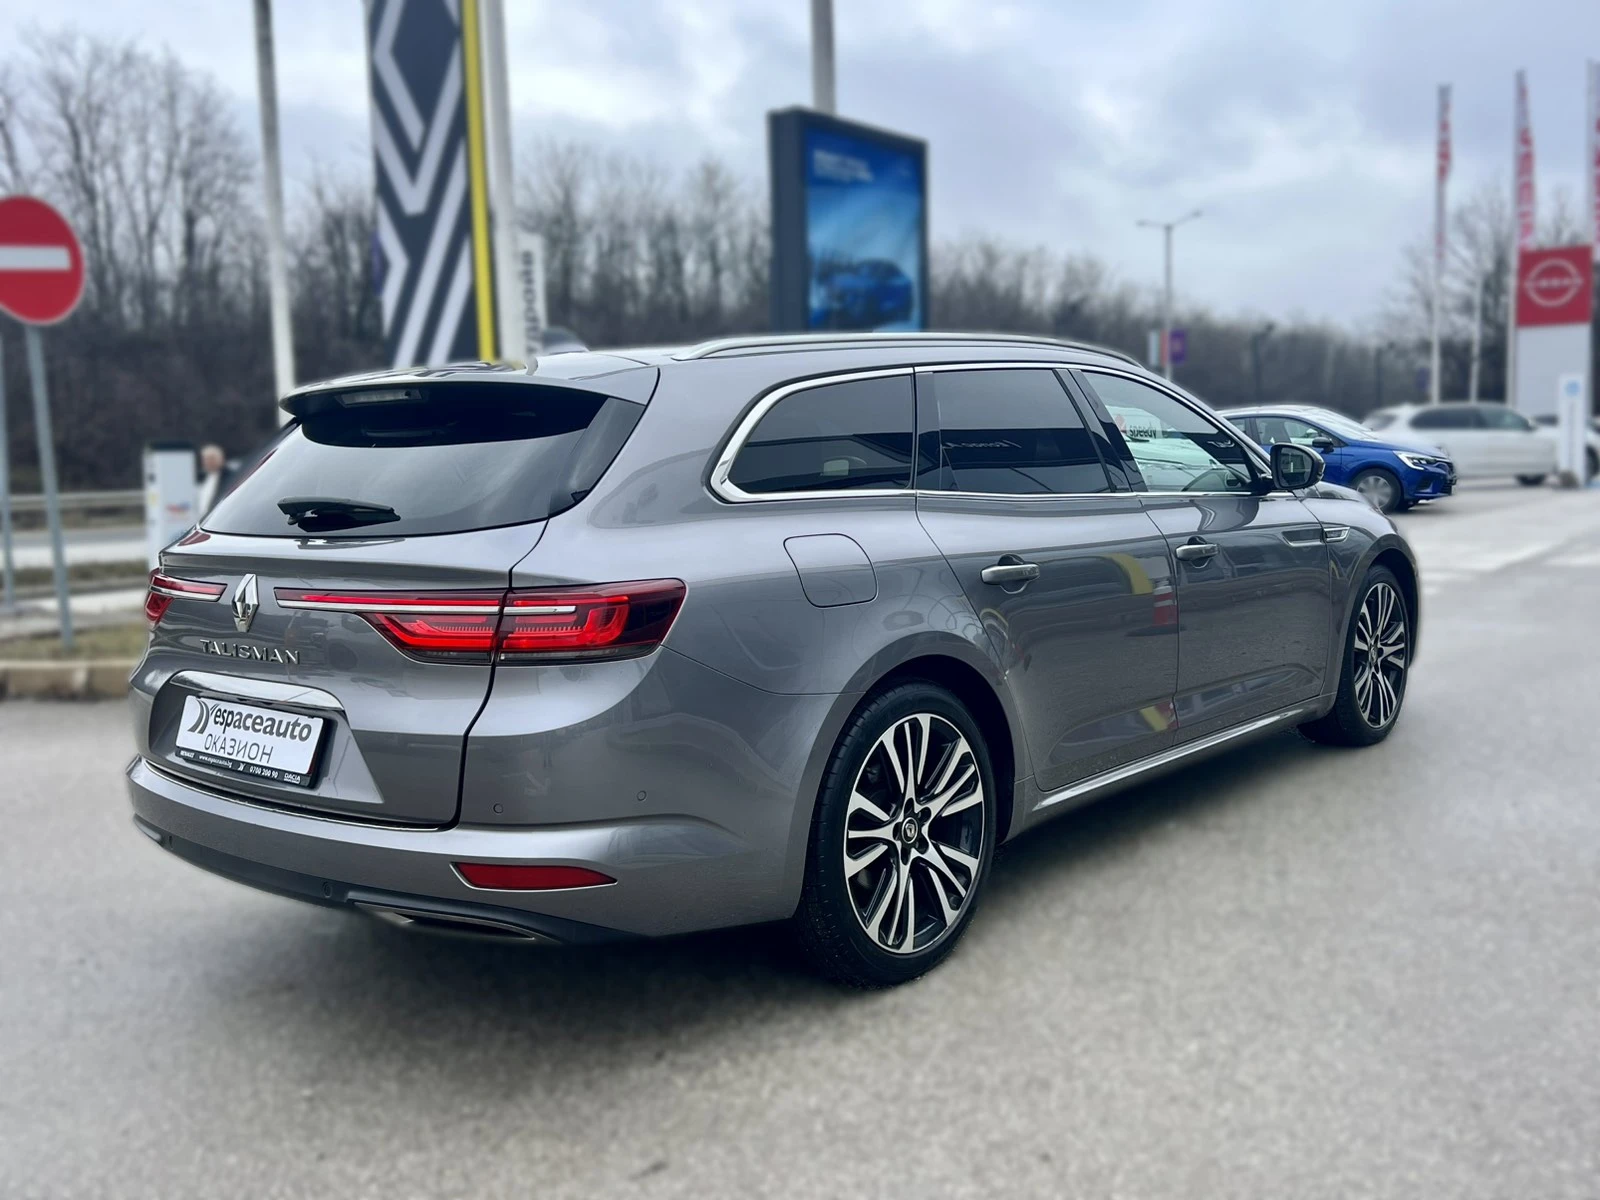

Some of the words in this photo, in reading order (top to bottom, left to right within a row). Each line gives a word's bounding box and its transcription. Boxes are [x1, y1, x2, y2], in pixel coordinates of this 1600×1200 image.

[199, 639, 300, 664] TALISMAN
[213, 707, 312, 742] espaceauto
[204, 733, 274, 763] ОКАЗИОН
[284, 772, 301, 783] DACIA
